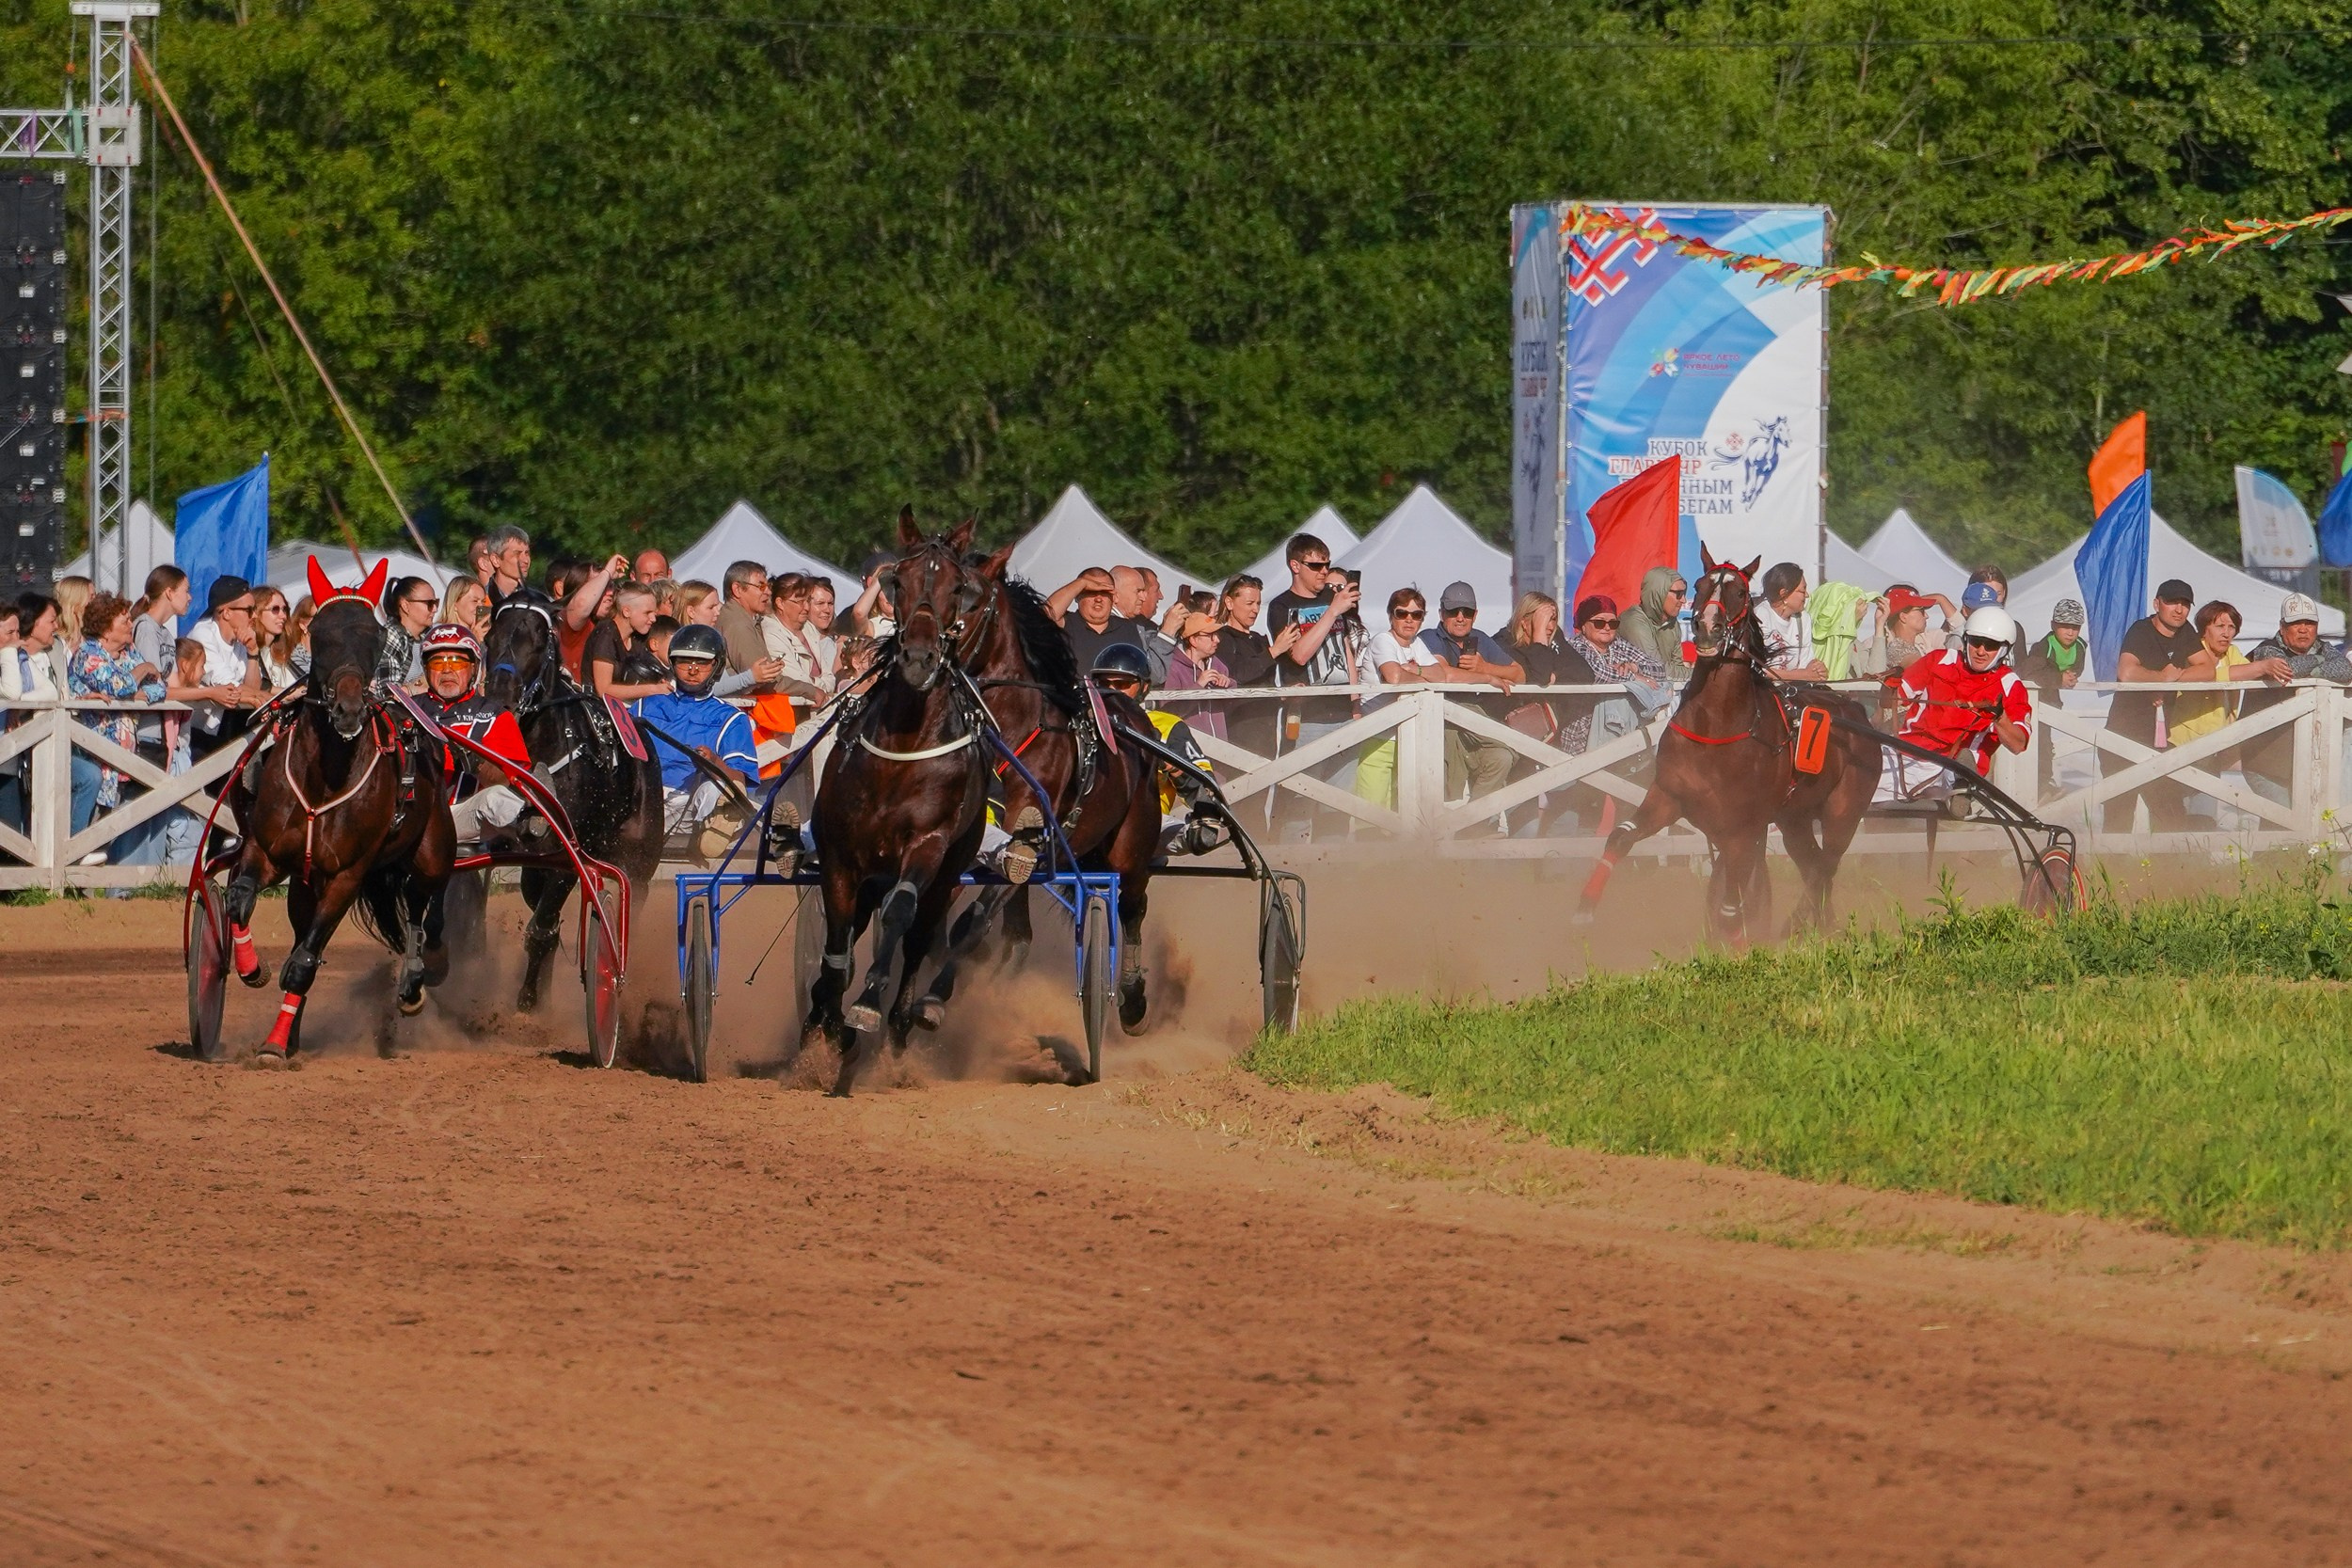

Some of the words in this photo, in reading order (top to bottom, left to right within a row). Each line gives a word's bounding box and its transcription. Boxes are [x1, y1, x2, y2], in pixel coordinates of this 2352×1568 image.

[1650, 440, 1708, 456] КУБОК
[1610, 458, 1661, 473] ГЛА
[1680, 459, 1701, 475] ЧР
[611, 698, 639, 748] 3
[1805, 710, 1825, 760] 7
